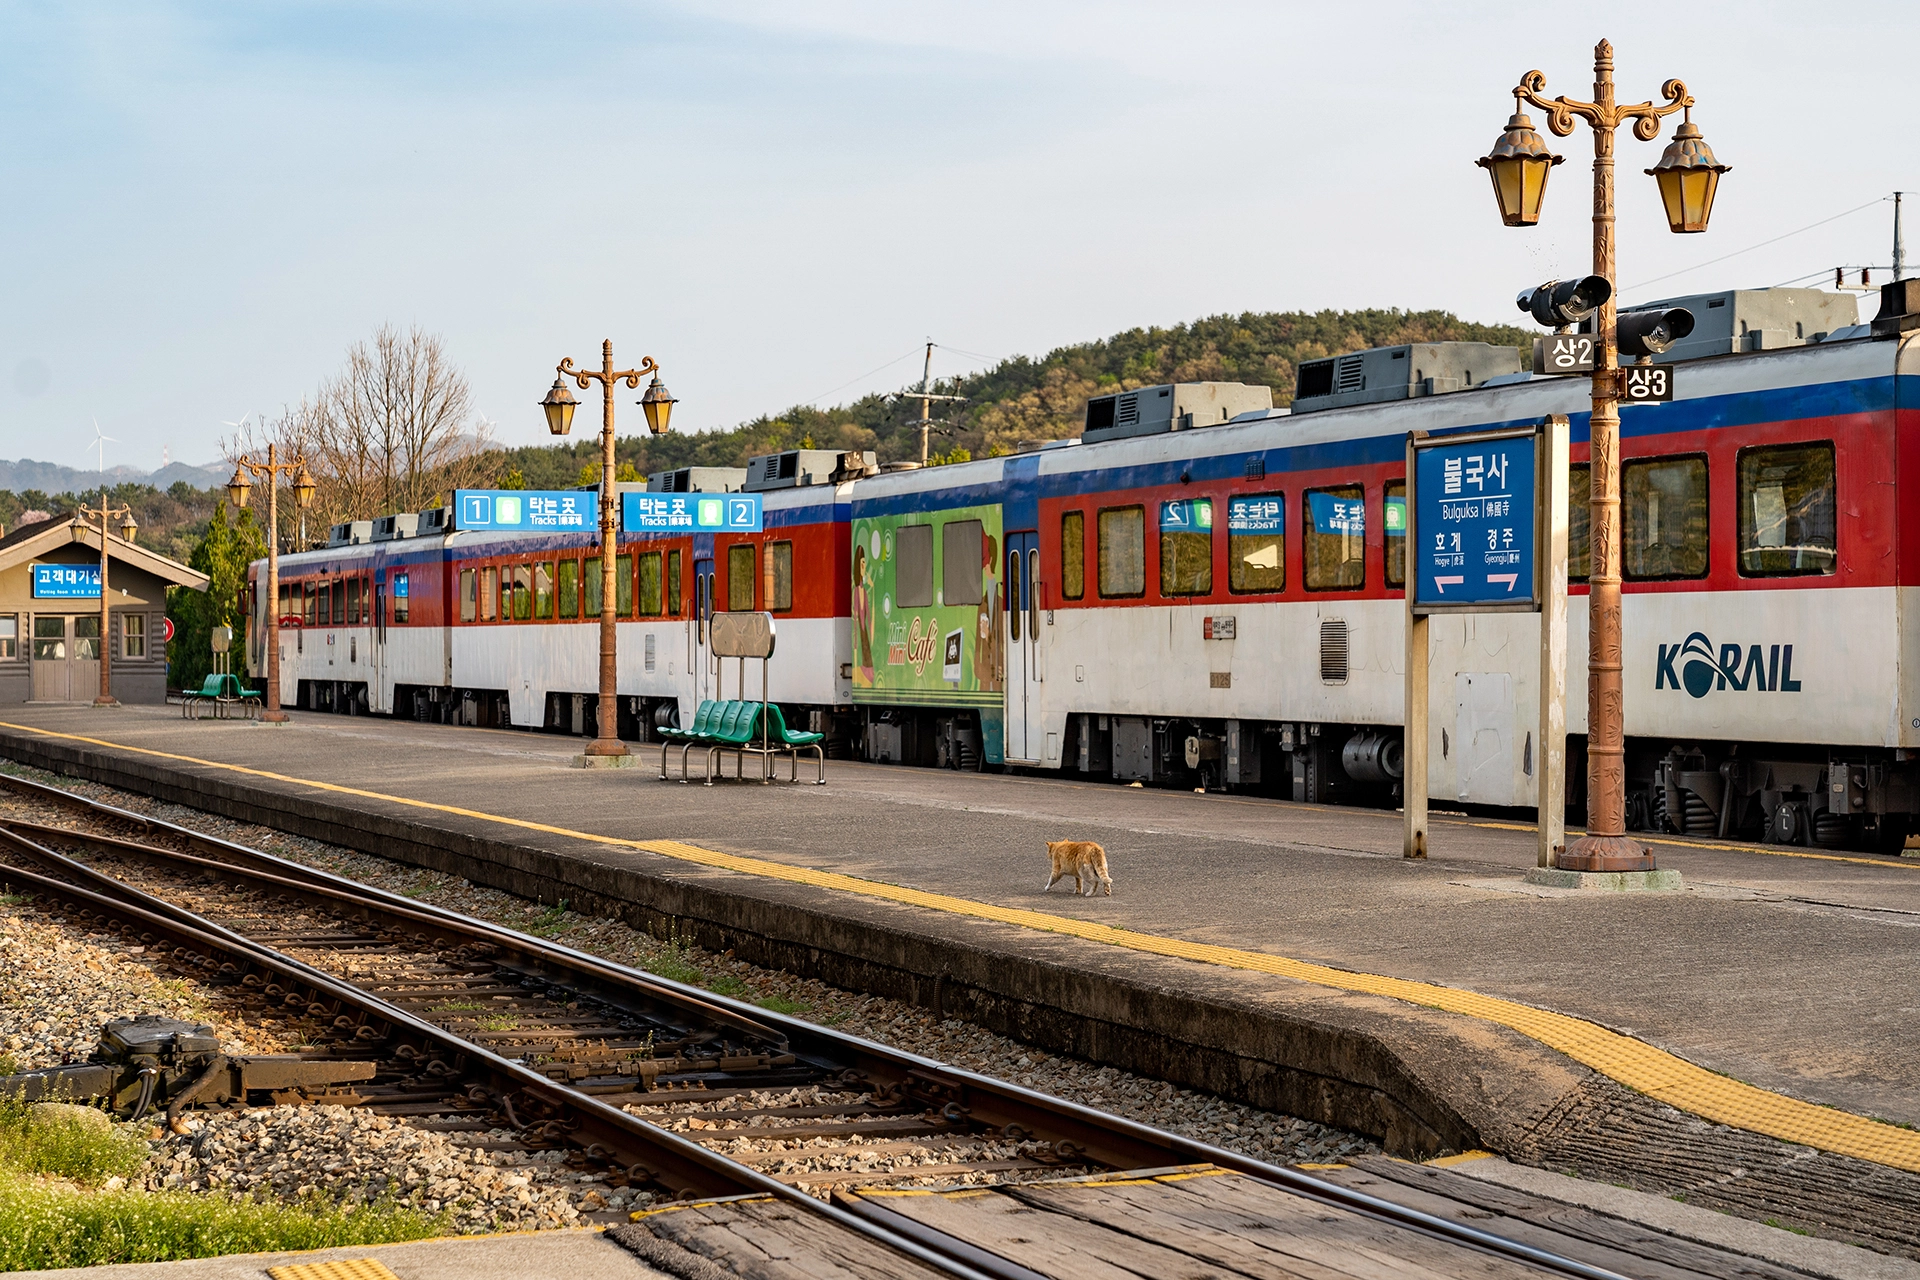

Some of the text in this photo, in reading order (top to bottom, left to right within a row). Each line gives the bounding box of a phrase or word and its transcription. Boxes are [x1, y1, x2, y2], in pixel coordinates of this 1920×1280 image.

[1552, 338, 1592, 367] 상2
[1628, 369, 1666, 398] 상3
[1444, 453, 1509, 494] 불국사
[471, 500, 480, 519] 1
[529, 497, 575, 514] 타는 곳
[640, 498, 685, 515] 타는 곳
[735, 503, 747, 523] 2
[1442, 502, 1479, 523] Bulguksa
[1486, 500, 1510, 517] 佛國寺
[530, 515, 557, 525] Tracks
[641, 516, 667, 526] Tracks
[1435, 532, 1461, 552] 호계
[1487, 528, 1513, 550] 경주
[1434, 556, 1450, 567] Hogye
[1485, 553, 1506, 565] Gyeongju
[39, 569, 102, 585] 고객대기실
[1655, 631, 1802, 699] KORAIL
